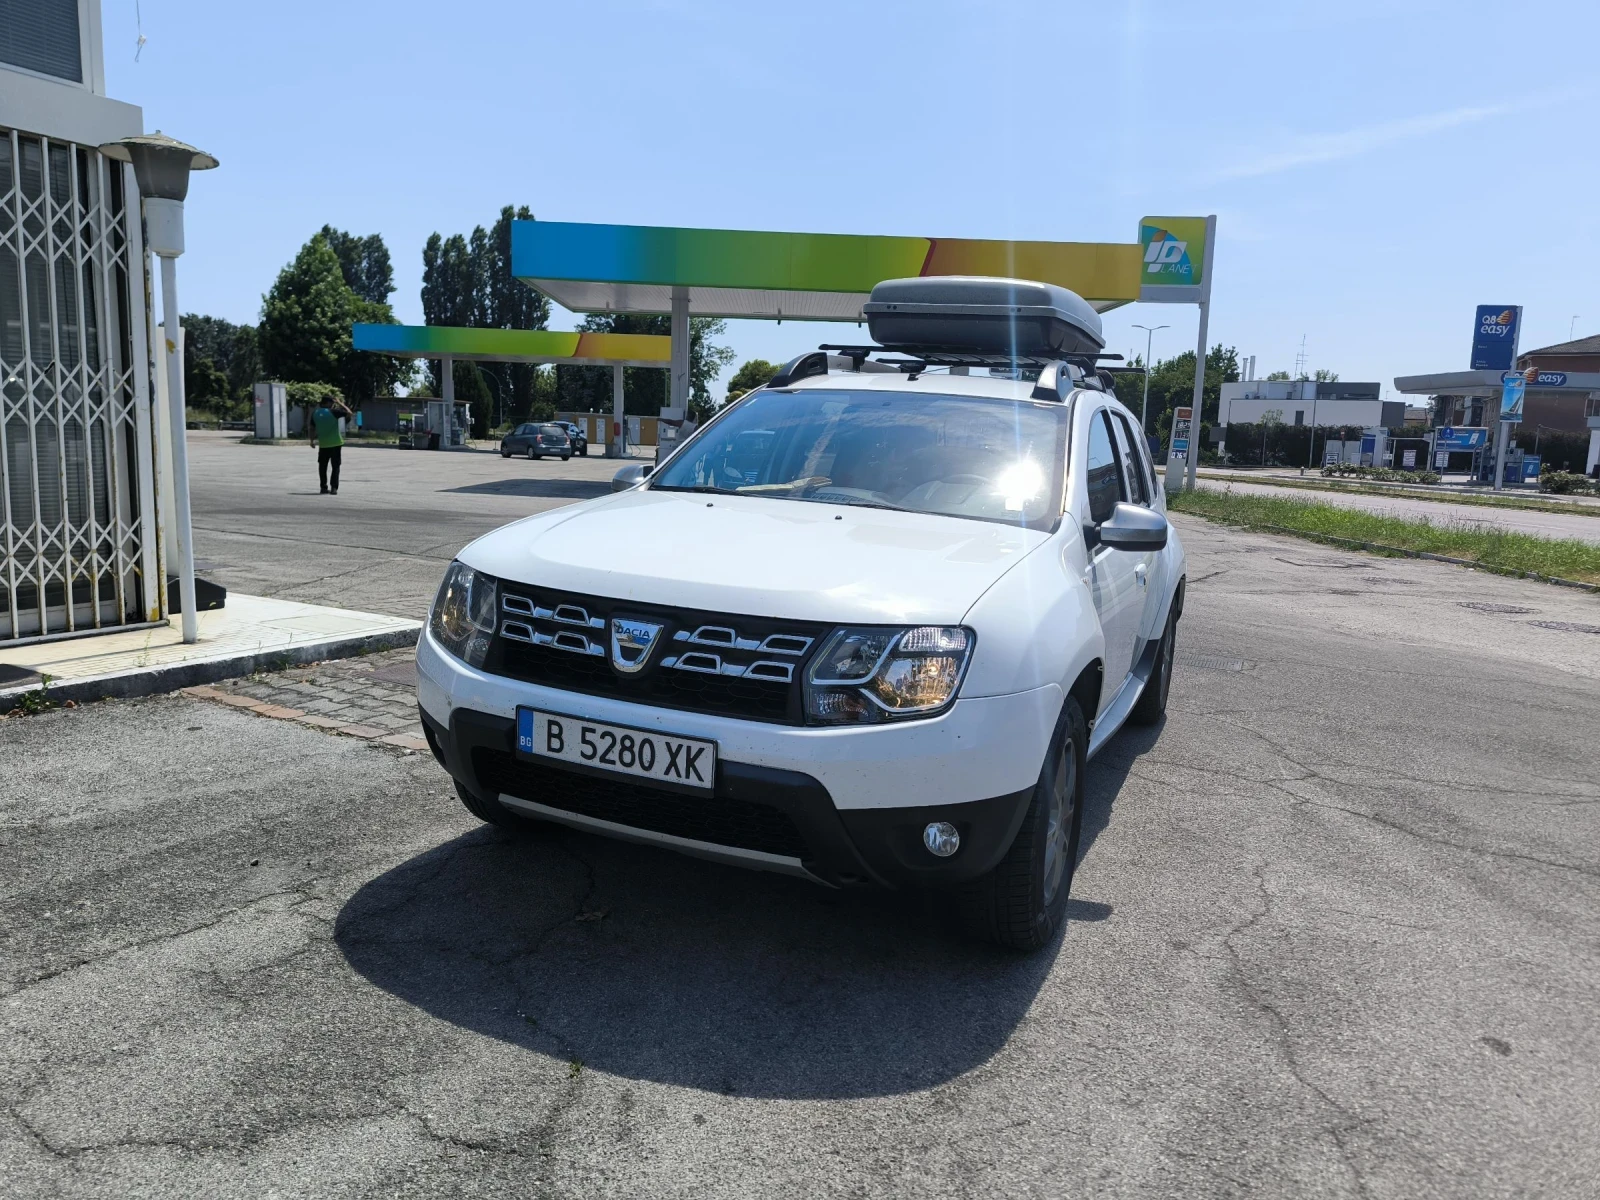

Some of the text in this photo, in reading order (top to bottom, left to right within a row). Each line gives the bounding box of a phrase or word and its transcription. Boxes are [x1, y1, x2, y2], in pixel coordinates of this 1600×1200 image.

[1482, 315, 1497, 325] Q8
[1480, 325, 1510, 338] easy
[1538, 374, 1564, 385] easy
[616, 627, 651, 639] DACIA
[520, 735, 532, 747] BG
[546, 719, 705, 783] B 5280 XK
